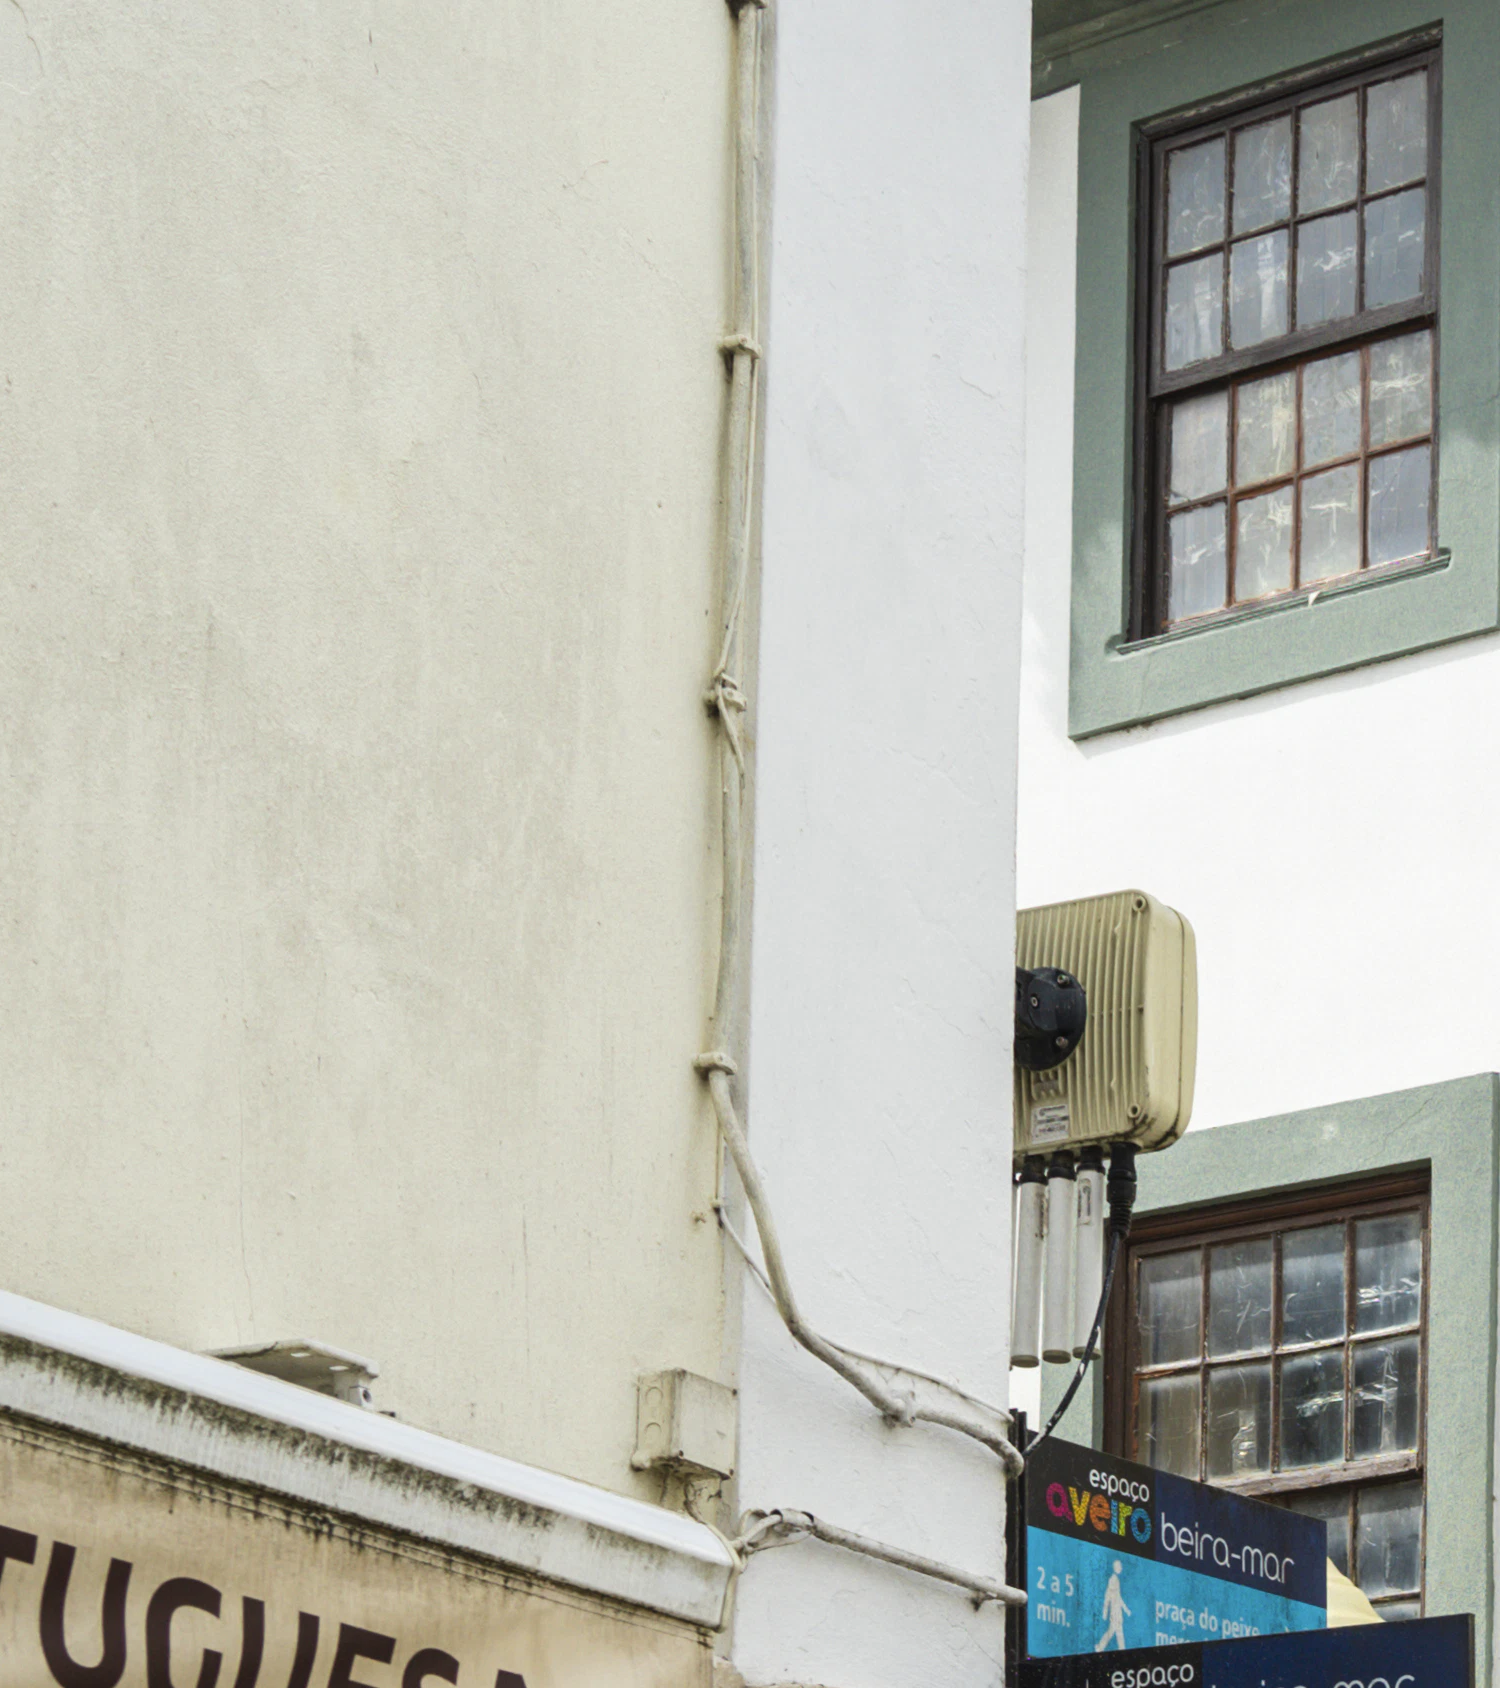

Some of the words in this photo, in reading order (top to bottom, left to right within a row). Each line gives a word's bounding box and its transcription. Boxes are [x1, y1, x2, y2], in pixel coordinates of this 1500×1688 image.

[1089, 1467, 1151, 1503] espaço
[1045, 1481, 1152, 1544] aveiro
[1160, 1512, 1296, 1585] beira-mar
[1036, 1566, 1046, 1590] 2
[1051, 1575, 1061, 1594] a
[1065, 1573, 1074, 1597] 5
[1036, 1600, 1071, 1628] min.
[1155, 1599, 1195, 1631] praça
[1199, 1606, 1218, 1632] do
[1221, 1616, 1261, 1640] peixe
